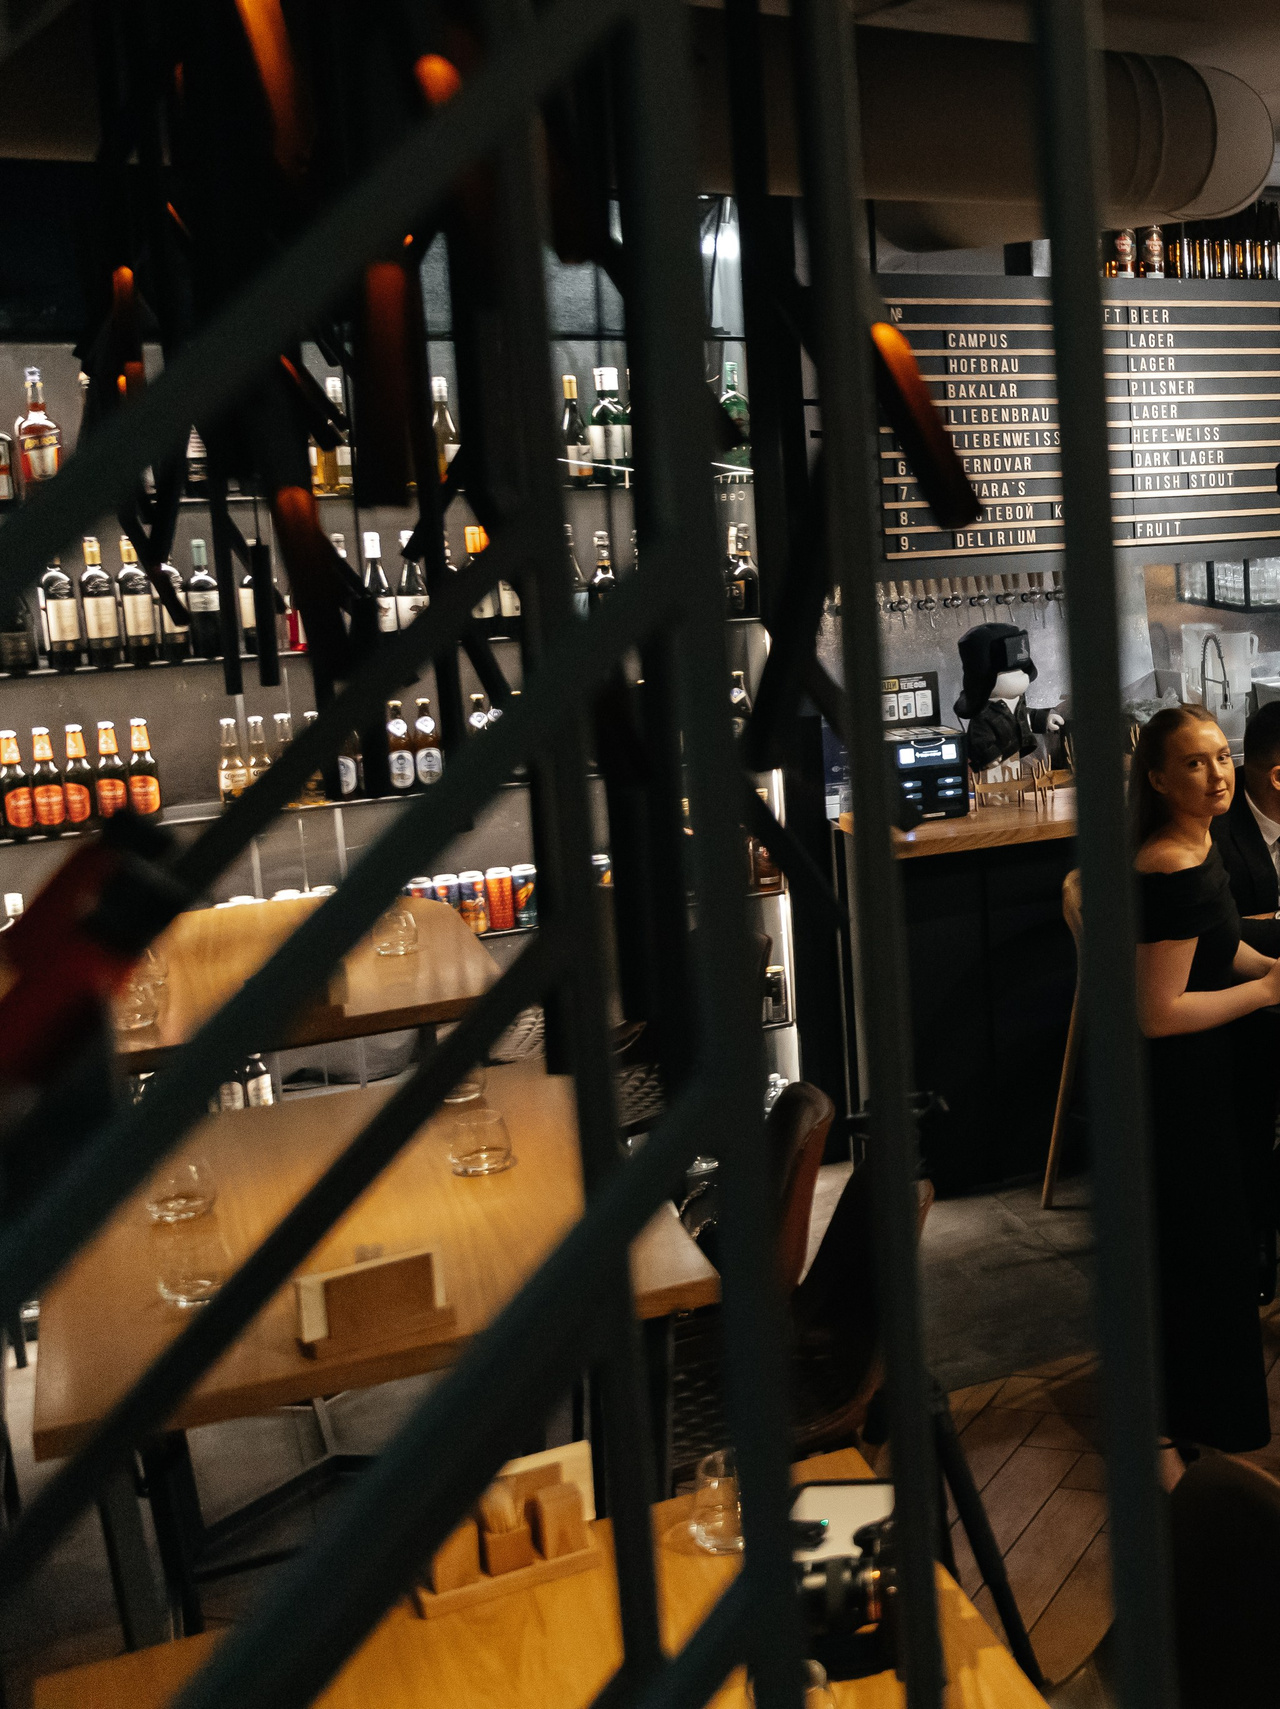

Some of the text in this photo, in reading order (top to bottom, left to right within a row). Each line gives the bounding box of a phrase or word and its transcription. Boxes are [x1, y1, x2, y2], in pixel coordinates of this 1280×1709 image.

[1130, 309, 1170, 324] BEER
[948, 333, 1008, 348] CAMPUS
[1129, 333, 1175, 348] LAGER
[949, 358, 1019, 373] HOFBRAU
[1130, 357, 1176, 372] LAGER
[948, 383, 1018, 398] BAKALAR
[1131, 380, 1195, 396] PILSNER
[950, 407, 1050, 424] LIEBENBRAU
[1133, 403, 1178, 419] LAGER
[952, 431, 1061, 449] LIEBENWEISS
[1133, 426, 1221, 443] HEFE-WEISS
[898, 461, 914, 476] 6.
[962, 456, 1032, 473] ERNOVAR
[1135, 453, 1171, 467] DARK
[1181, 450, 1224, 465] LAGER
[900, 486, 916, 501] 7.
[1137, 474, 1181, 490] IRISH
[1190, 472, 1234, 488] STOUT
[900, 511, 916, 526] 8.
[901, 536, 917, 551] 9.
[956, 529, 1037, 548] DELIRIUM
[1136, 521, 1182, 538] FRUIT
